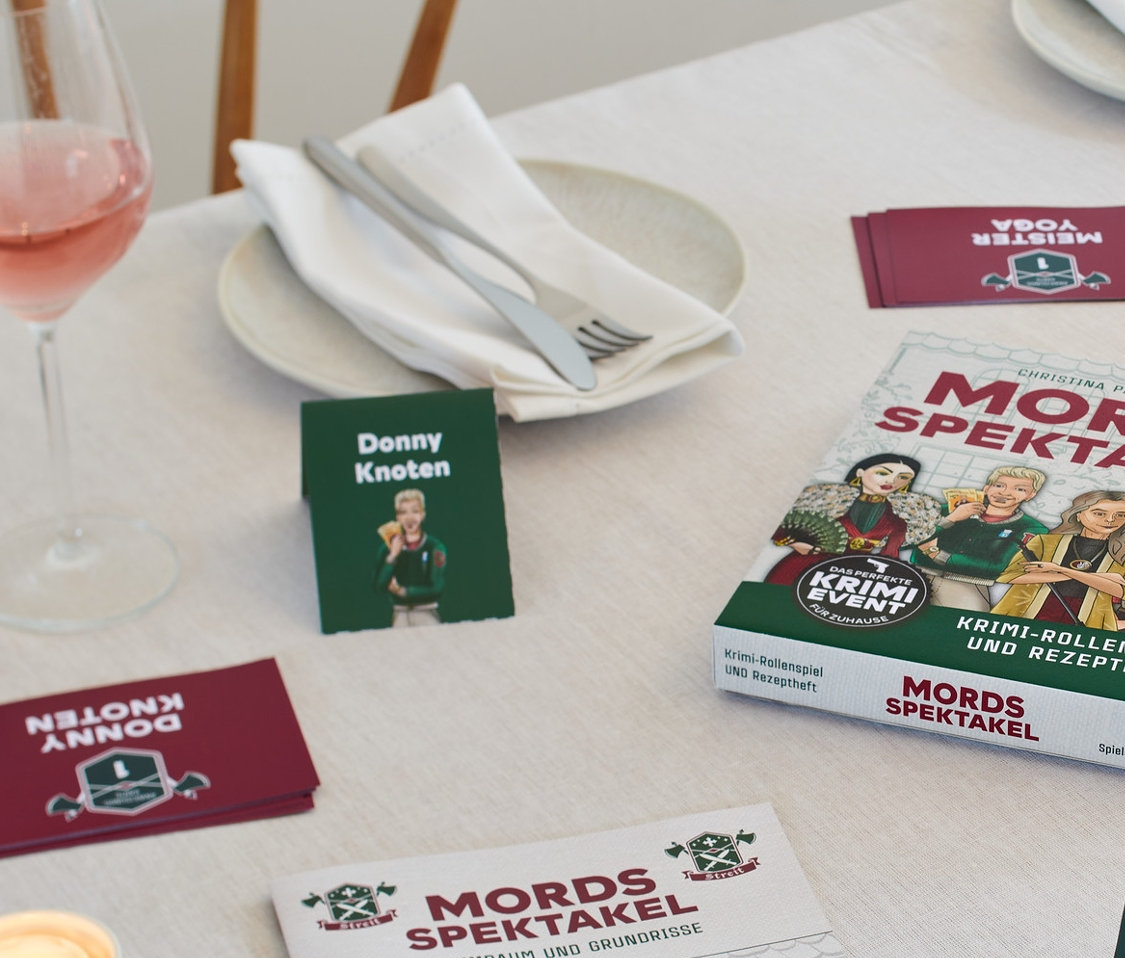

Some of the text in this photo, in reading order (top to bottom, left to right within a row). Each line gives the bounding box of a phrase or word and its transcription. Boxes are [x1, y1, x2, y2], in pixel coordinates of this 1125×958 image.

[971, 232, 1103, 246] MEISTER
[991, 219, 1078, 232] YOGA
[1037, 257, 1049, 270] 1
[1017, 368, 1106, 390] CHRISTINA
[357, 432, 442, 455] Donny
[355, 460, 451, 484] Knoten
[809, 571, 919, 604] KRIMI
[829, 566, 913, 586] DAS PERFEKTE
[807, 587, 906, 615] EVENT
[809, 603, 889, 624] FÜR ZUHAUSE
[967, 636, 1017, 656] UND
[724, 648, 824, 678] Krimi-Rollenspiel
[725, 664, 817, 693] UND Rezeptheft
[902, 675, 1025, 718] MORDS
[25, 693, 184, 735] KNOTEN
[886, 697, 1040, 742] SPEKTAKEL
[41, 713, 182, 754] DONNY
[113, 760, 130, 779] 1
[425, 868, 656, 921] MORDS
[406, 895, 699, 950] SPEKTAKEL
[544, 944, 580, 958] UND
[589, 922, 703, 952] GRUNDRISSE
